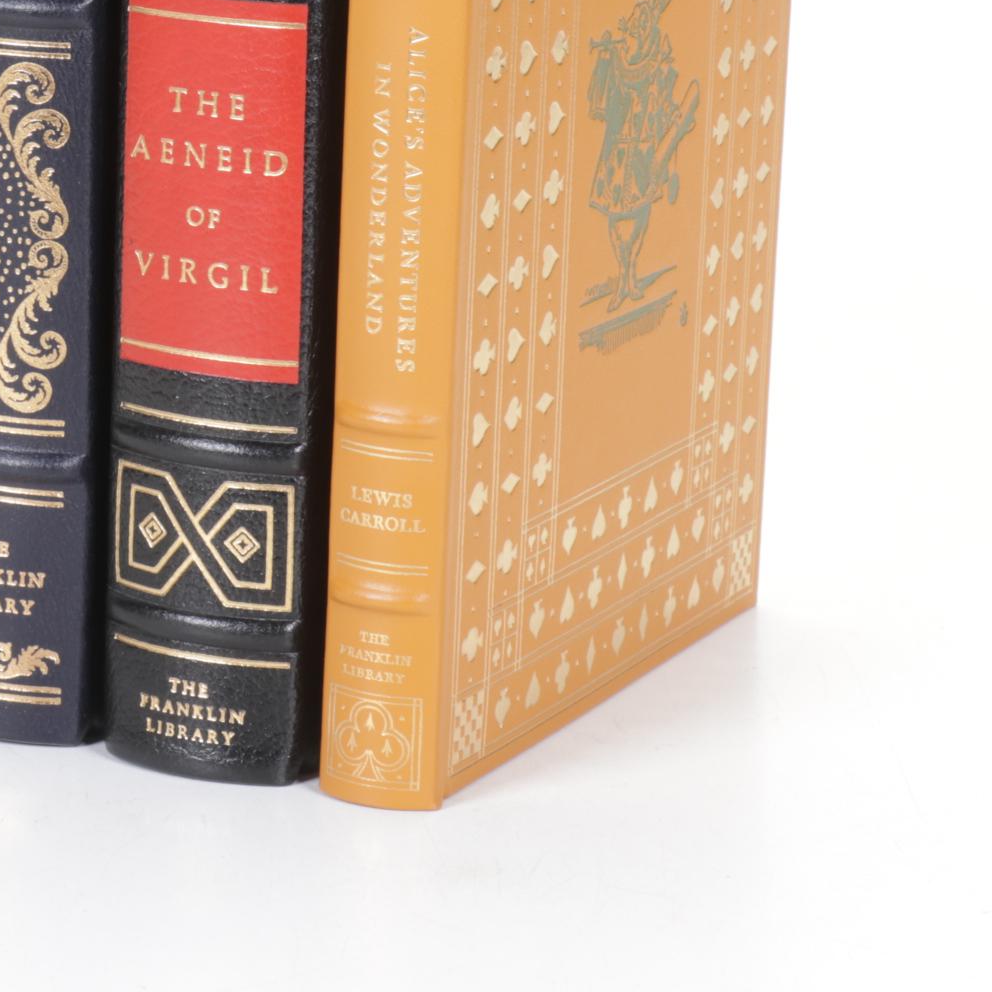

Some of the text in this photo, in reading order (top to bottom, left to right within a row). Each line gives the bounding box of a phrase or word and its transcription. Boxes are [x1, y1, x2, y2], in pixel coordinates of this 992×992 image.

[169, 87, 246, 122] THE
[131, 135, 289, 176] AENEID
[365, 63, 394, 336] IN WONDERLAND
[396, 25, 430, 374] ALICE'S ADVENTURES
[186, 206, 221, 230] OF
[135, 250, 280, 293] VIRGIL
[351, 485, 413, 508] LEWIS
[340, 508, 426, 533] CARROLL
[359, 630, 390, 646] THE
[339, 645, 412, 666] FRANKLIN
[342, 663, 407, 684] LIBRARY
[169, 678, 209, 699] THE
[139, 693, 246, 726] FRANKLIN
[145, 719, 236, 747] LIBRARY
